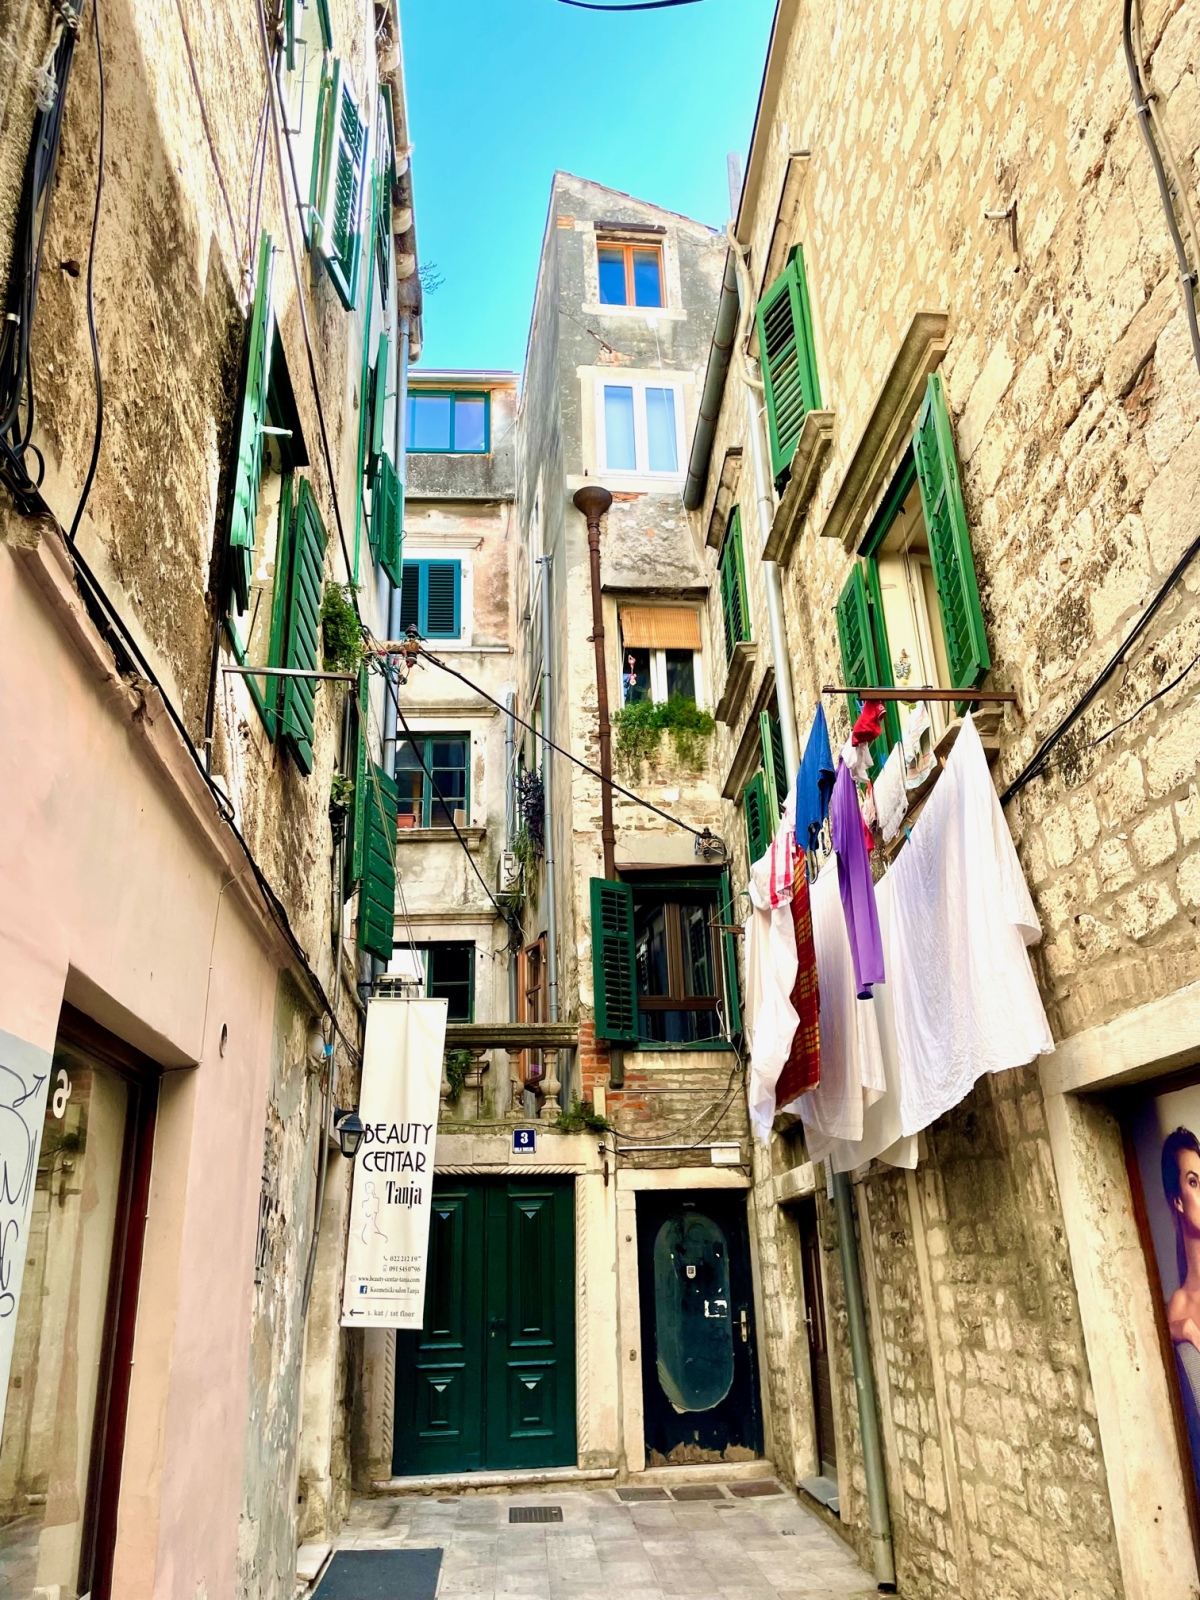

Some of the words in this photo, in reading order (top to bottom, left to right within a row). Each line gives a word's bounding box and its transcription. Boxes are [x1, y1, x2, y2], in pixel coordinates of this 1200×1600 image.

[363, 1123, 434, 1145] BEAUTY
[520, 1132, 529, 1144] 3
[362, 1151, 427, 1173] CENTAR
[385, 1180, 422, 1210] Tanja
